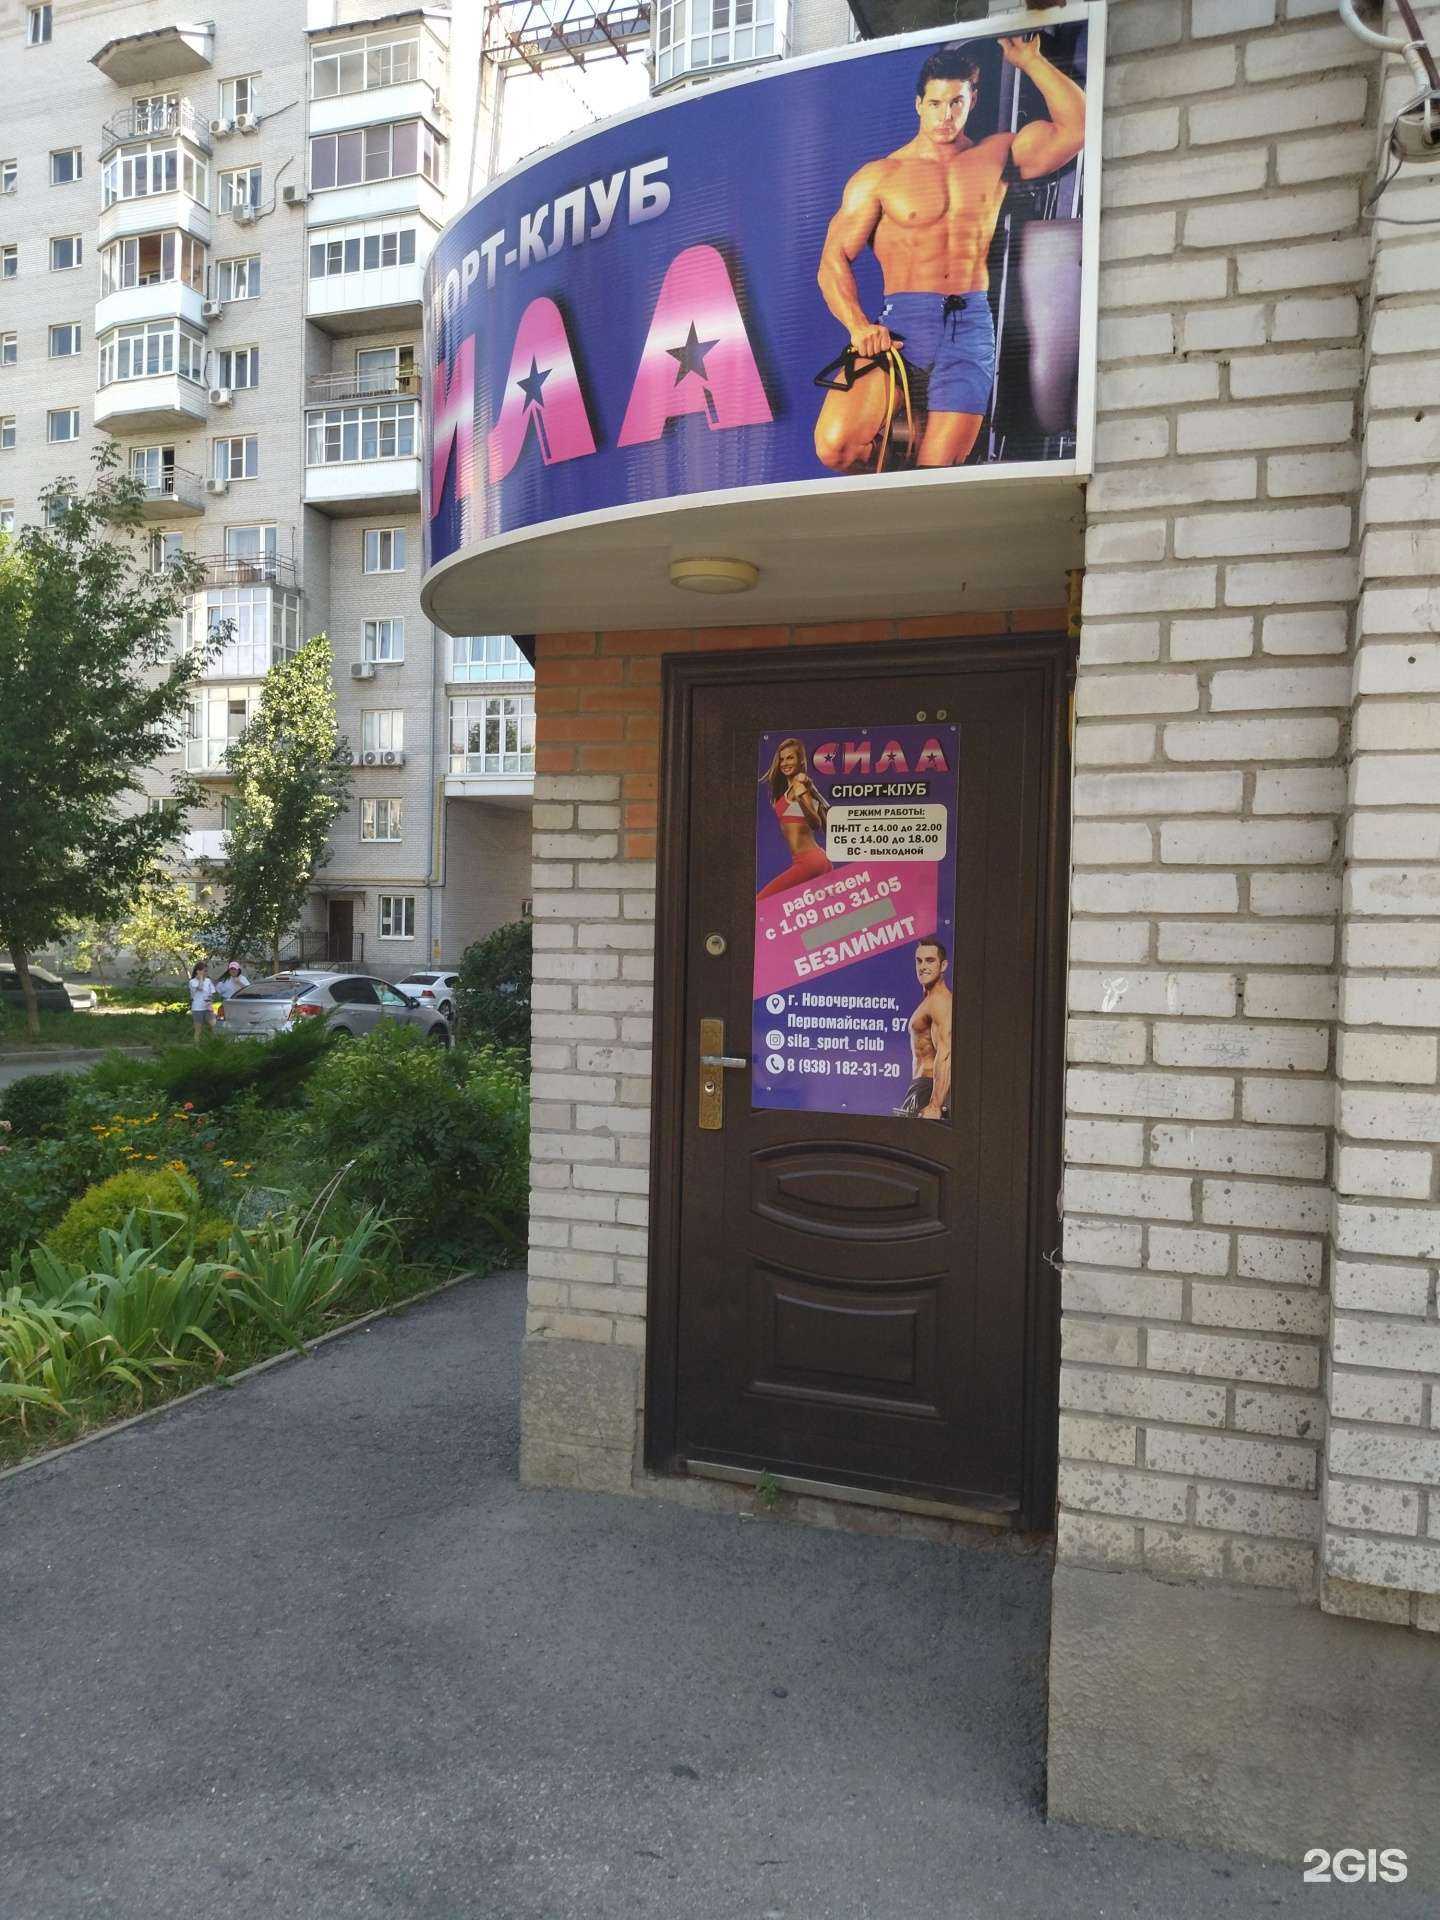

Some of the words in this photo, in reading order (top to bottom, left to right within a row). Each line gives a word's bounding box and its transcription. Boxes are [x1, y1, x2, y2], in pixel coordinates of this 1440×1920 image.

[434, 156, 671, 320] ОРТ-КЛУБ
[813, 738, 949, 775] СИЛА
[831, 783, 927, 798] СПОРТ-КЛУБ
[847, 808, 882, 817] РЕЖИМ
[884, 807, 926, 816] РАБОТЫ:
[830, 824, 862, 833] ПН-ПТ
[872, 824, 899, 832] 14.00
[915, 823, 942, 832] 22.00
[833, 836, 848, 844] СБ
[859, 835, 889, 844] 14.00
[892, 837, 905, 845] до
[908, 834, 939, 843] 18.00
[847, 847, 861, 856] ВС
[870, 846, 924, 856] выходной
[782, 870, 871, 917] работаем
[765, 927, 777, 940] с
[779, 908, 818, 935] 1.09
[822, 901, 846, 919] по
[848, 876, 902, 908] 31.05
[793, 916, 915, 976] БЕЗЛИМИТ
[787, 994, 799, 1006] г.
[802, 992, 900, 1011] Новочеркасск,
[787, 1013, 888, 1032] Первомайская,
[787, 1033, 885, 1052] sila_sport_club
[787, 1058, 795, 1072] 8
[799, 1058, 831, 1075] (938)
[834, 1060, 901, 1078] 182-31-20
